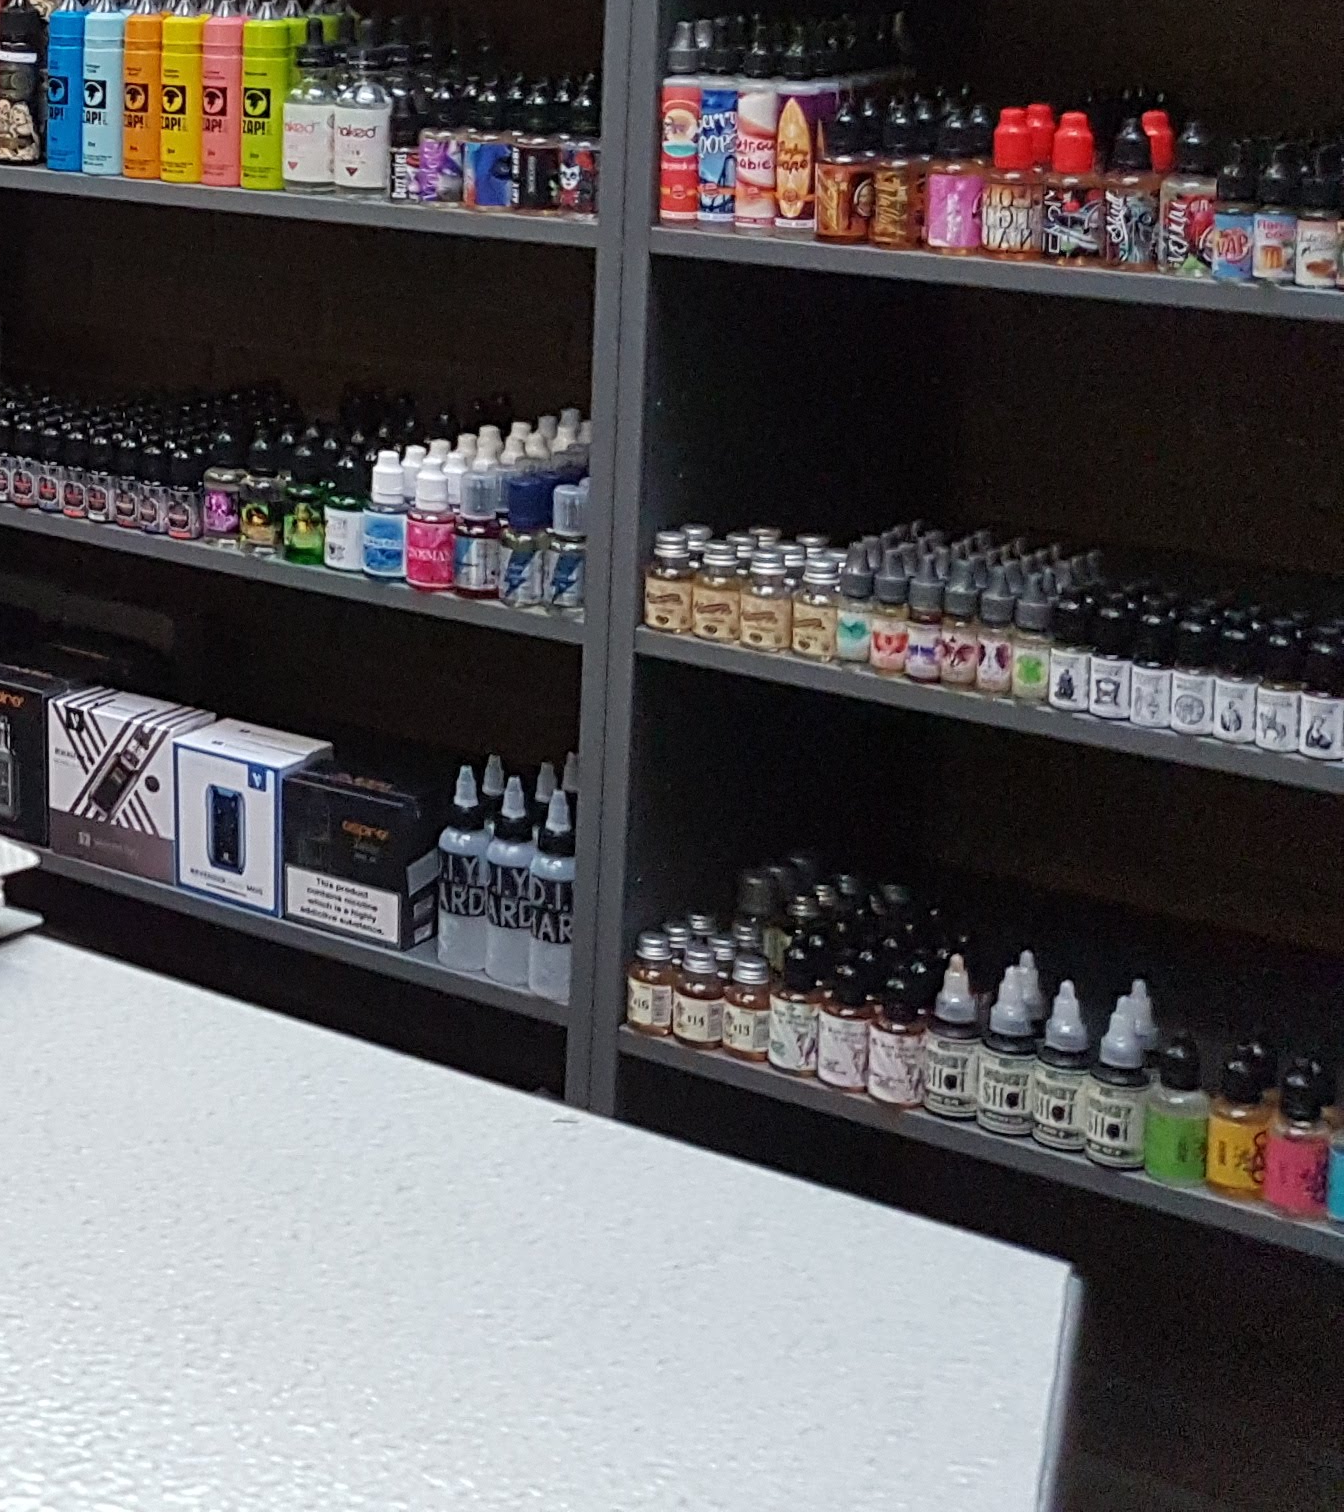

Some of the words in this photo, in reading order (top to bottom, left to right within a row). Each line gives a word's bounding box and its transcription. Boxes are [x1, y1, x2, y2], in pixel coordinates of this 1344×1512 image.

[243, 118, 266, 135] ZAP!
[306, 887, 341, 902] contains
[343, 896, 378, 912] nicotine
[316, 876, 334, 889] This
[335, 880, 369, 899] product
[307, 897, 331, 912] which
[350, 908, 377, 924] highly
